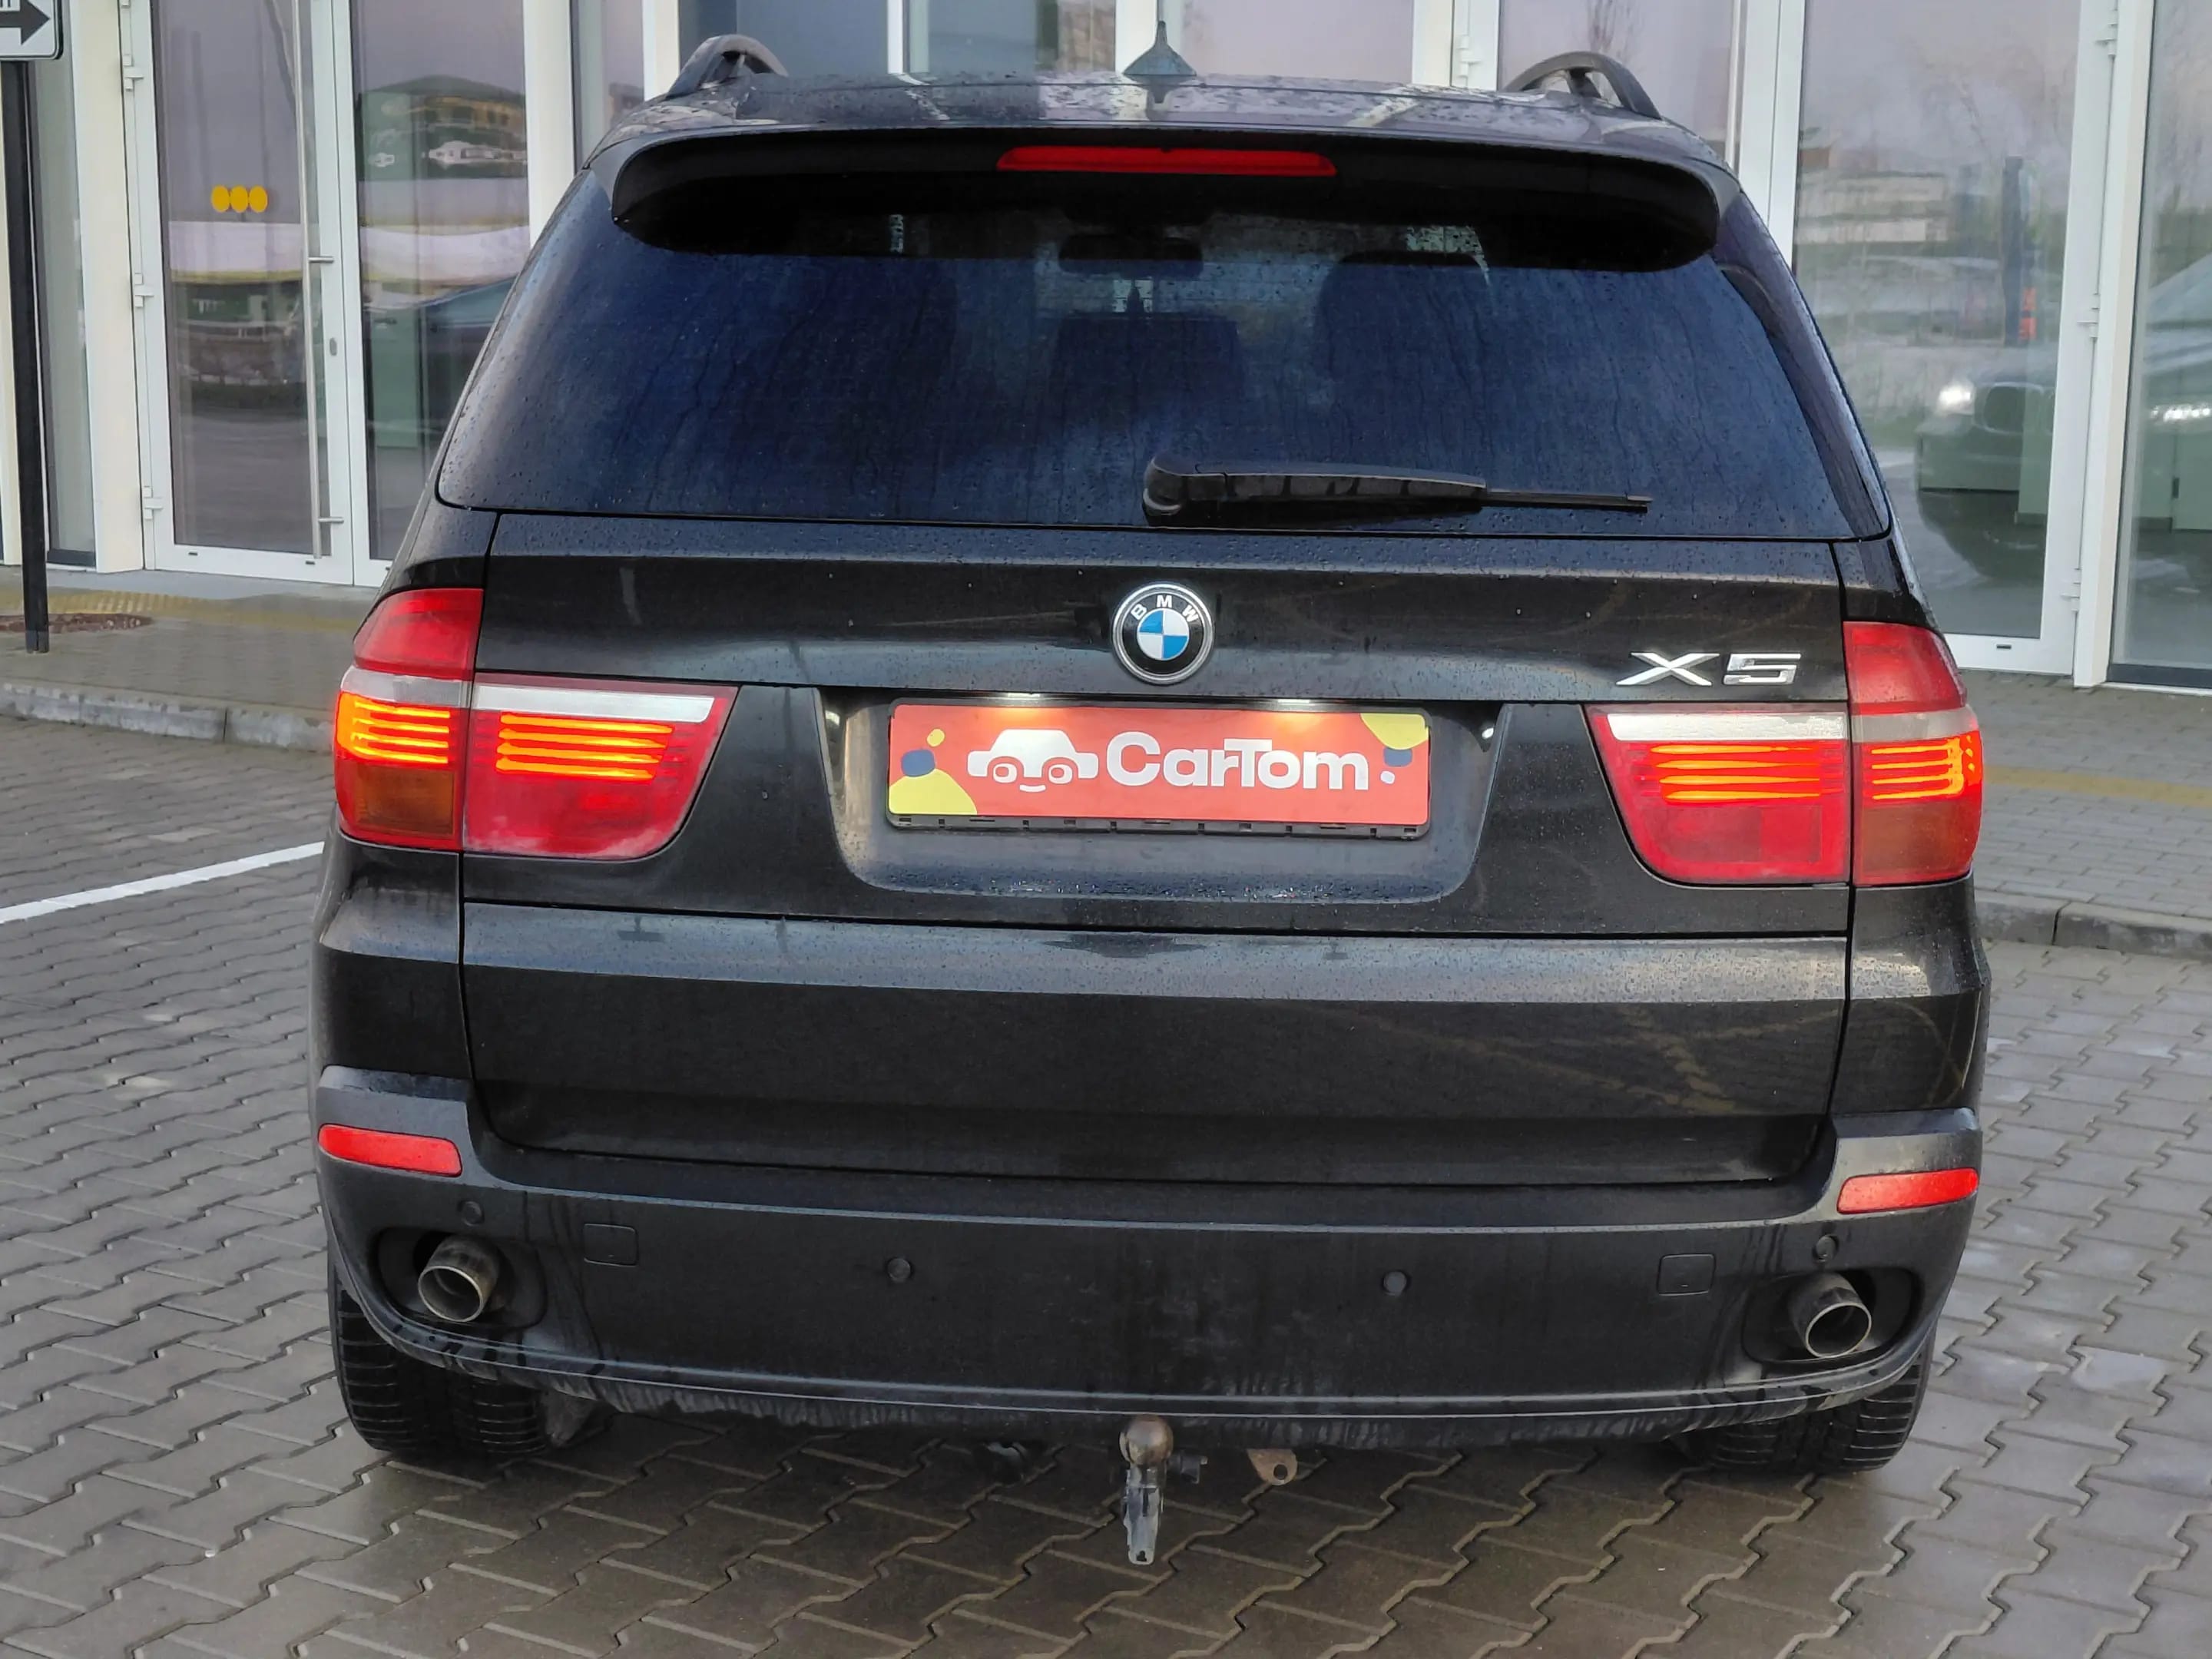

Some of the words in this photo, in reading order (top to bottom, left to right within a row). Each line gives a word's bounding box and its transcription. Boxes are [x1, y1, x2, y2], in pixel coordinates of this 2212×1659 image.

[1130, 594, 1199, 622] BMW
[1615, 652, 1802, 687] X5
[1106, 731, 1369, 790] CarTom
